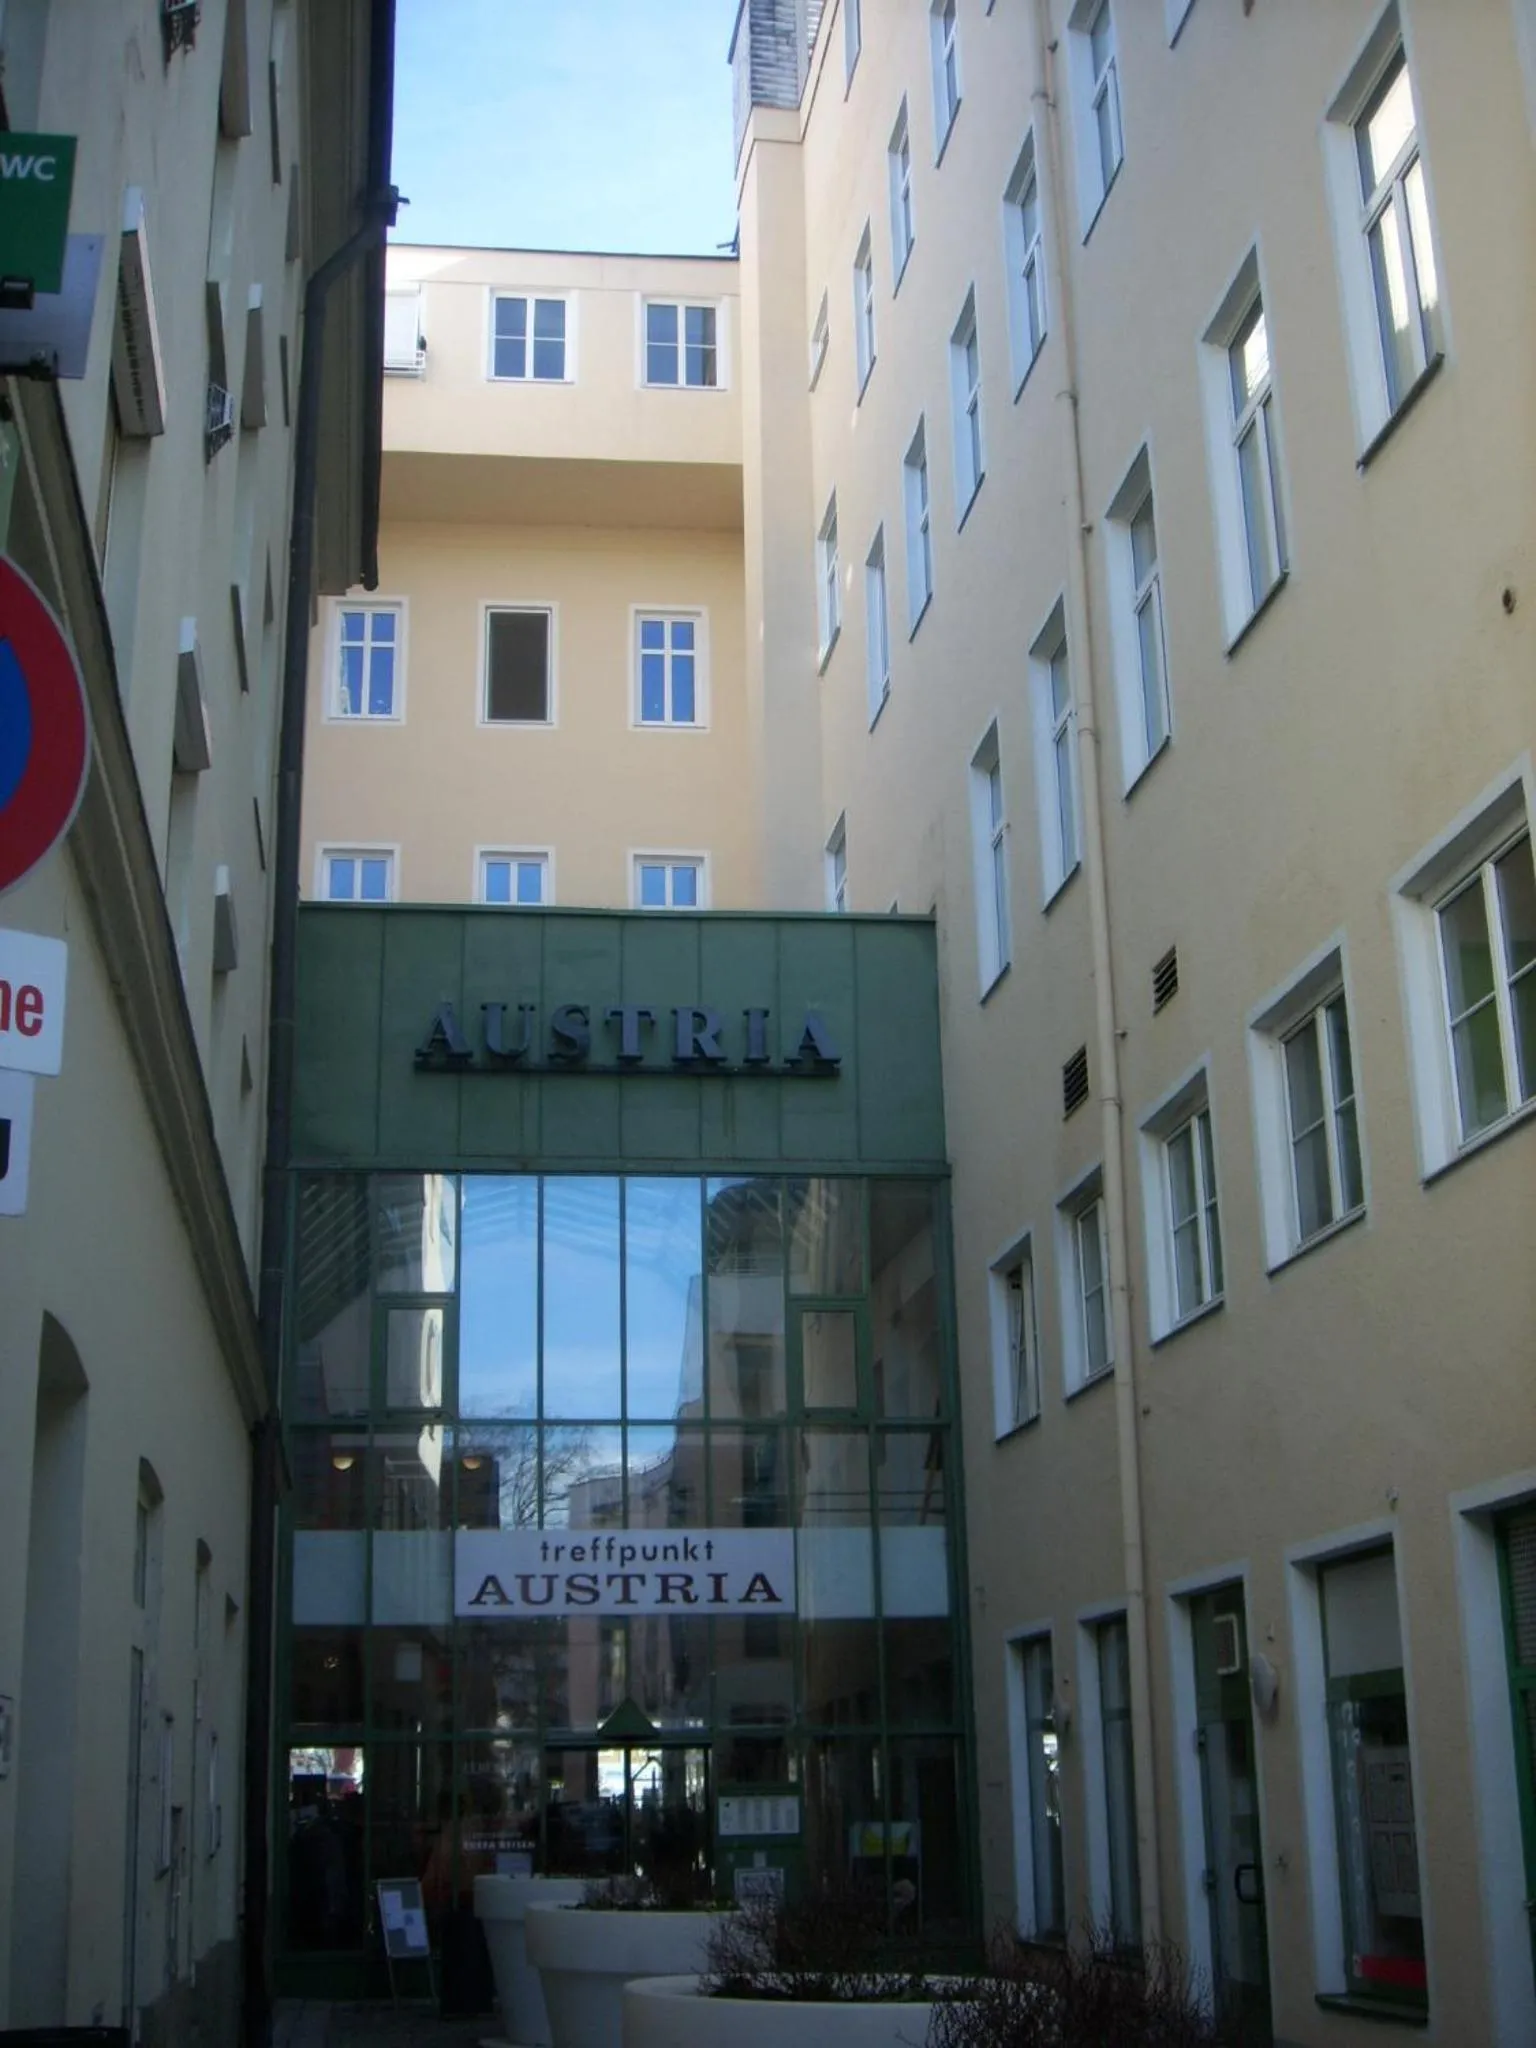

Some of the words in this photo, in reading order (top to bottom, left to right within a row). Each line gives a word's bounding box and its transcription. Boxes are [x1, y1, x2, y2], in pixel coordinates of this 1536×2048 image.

[0, 153, 56, 181] WC
[414, 1000, 842, 1068] AUSTRIA
[540, 1536, 714, 1567] treffpunkt
[467, 1572, 783, 1606] AUSTRIA
